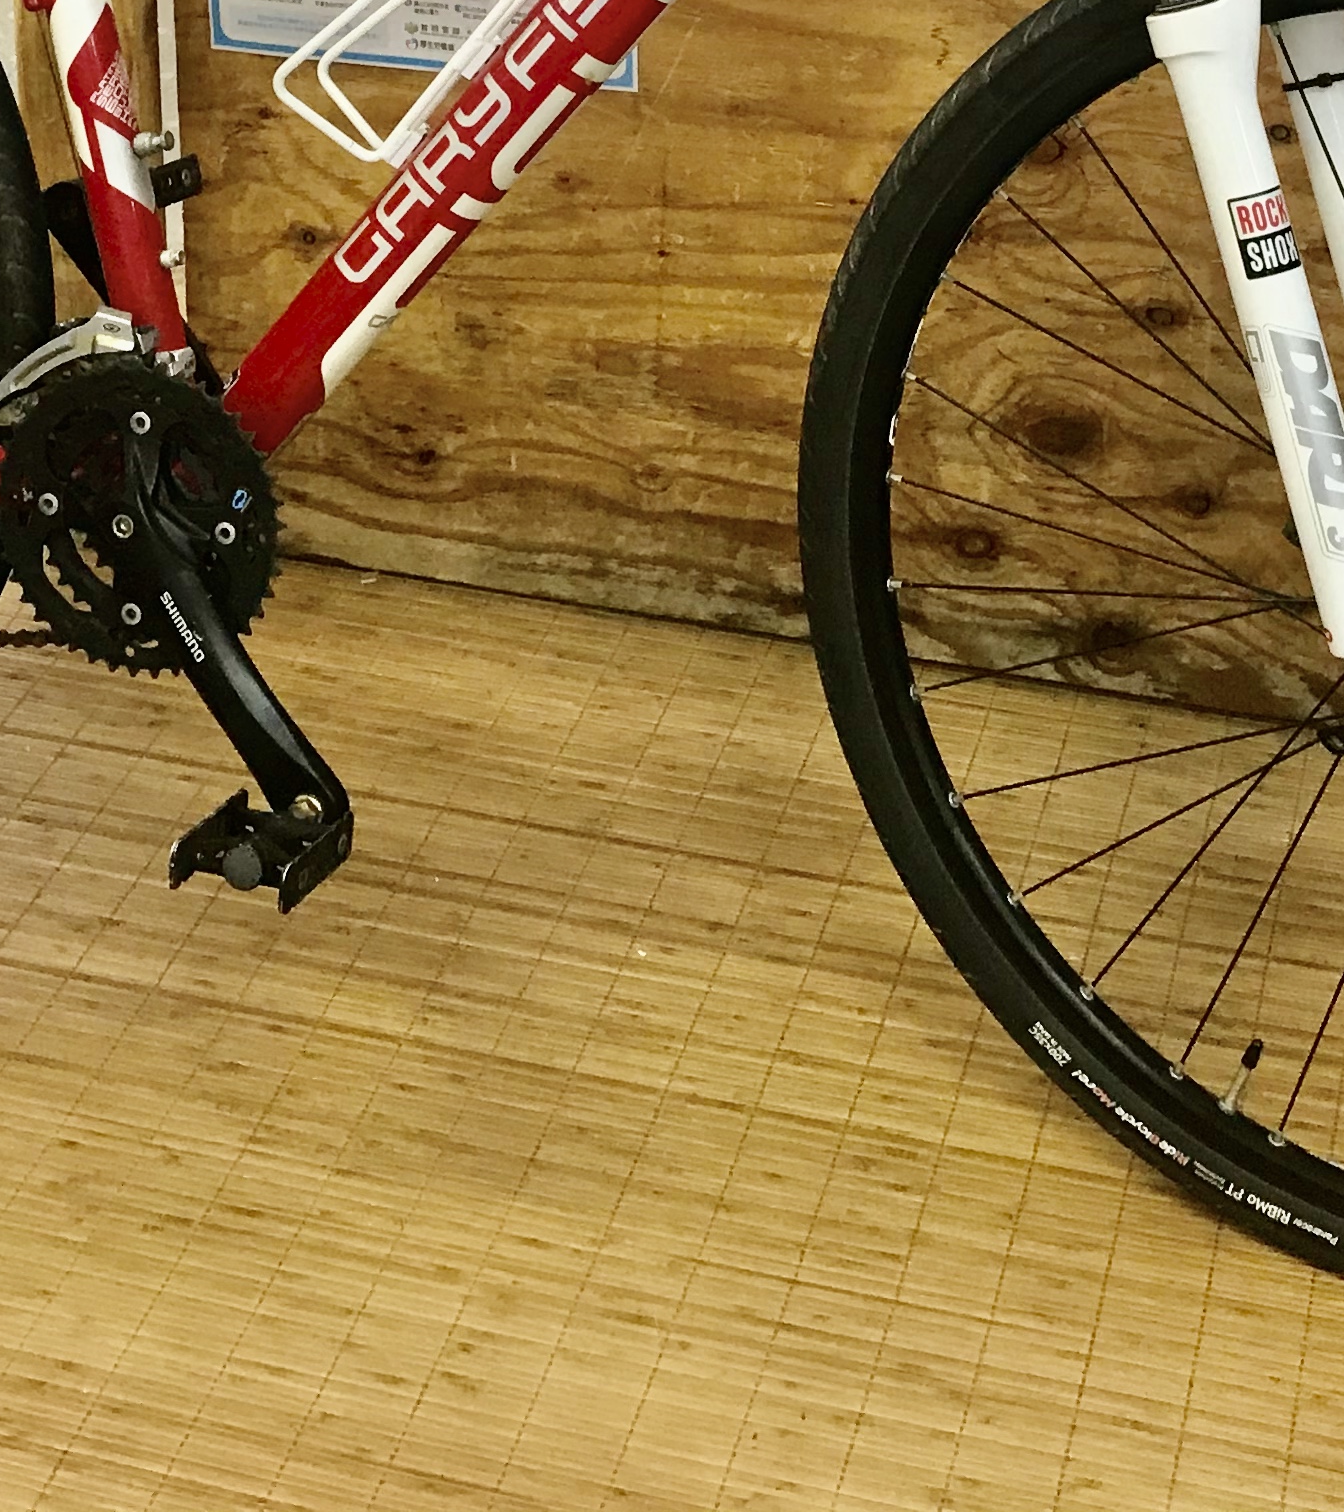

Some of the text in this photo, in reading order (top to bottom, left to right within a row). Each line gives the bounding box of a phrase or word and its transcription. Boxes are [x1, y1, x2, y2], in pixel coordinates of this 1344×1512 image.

[1237, 194, 1290, 236] ROCK
[1246, 230, 1299, 273] SHOX
[159, 590, 205, 665] SHIMANO
[1224, 1181, 1245, 1201] PT
[1246, 1193, 1291, 1226] RiBMo
